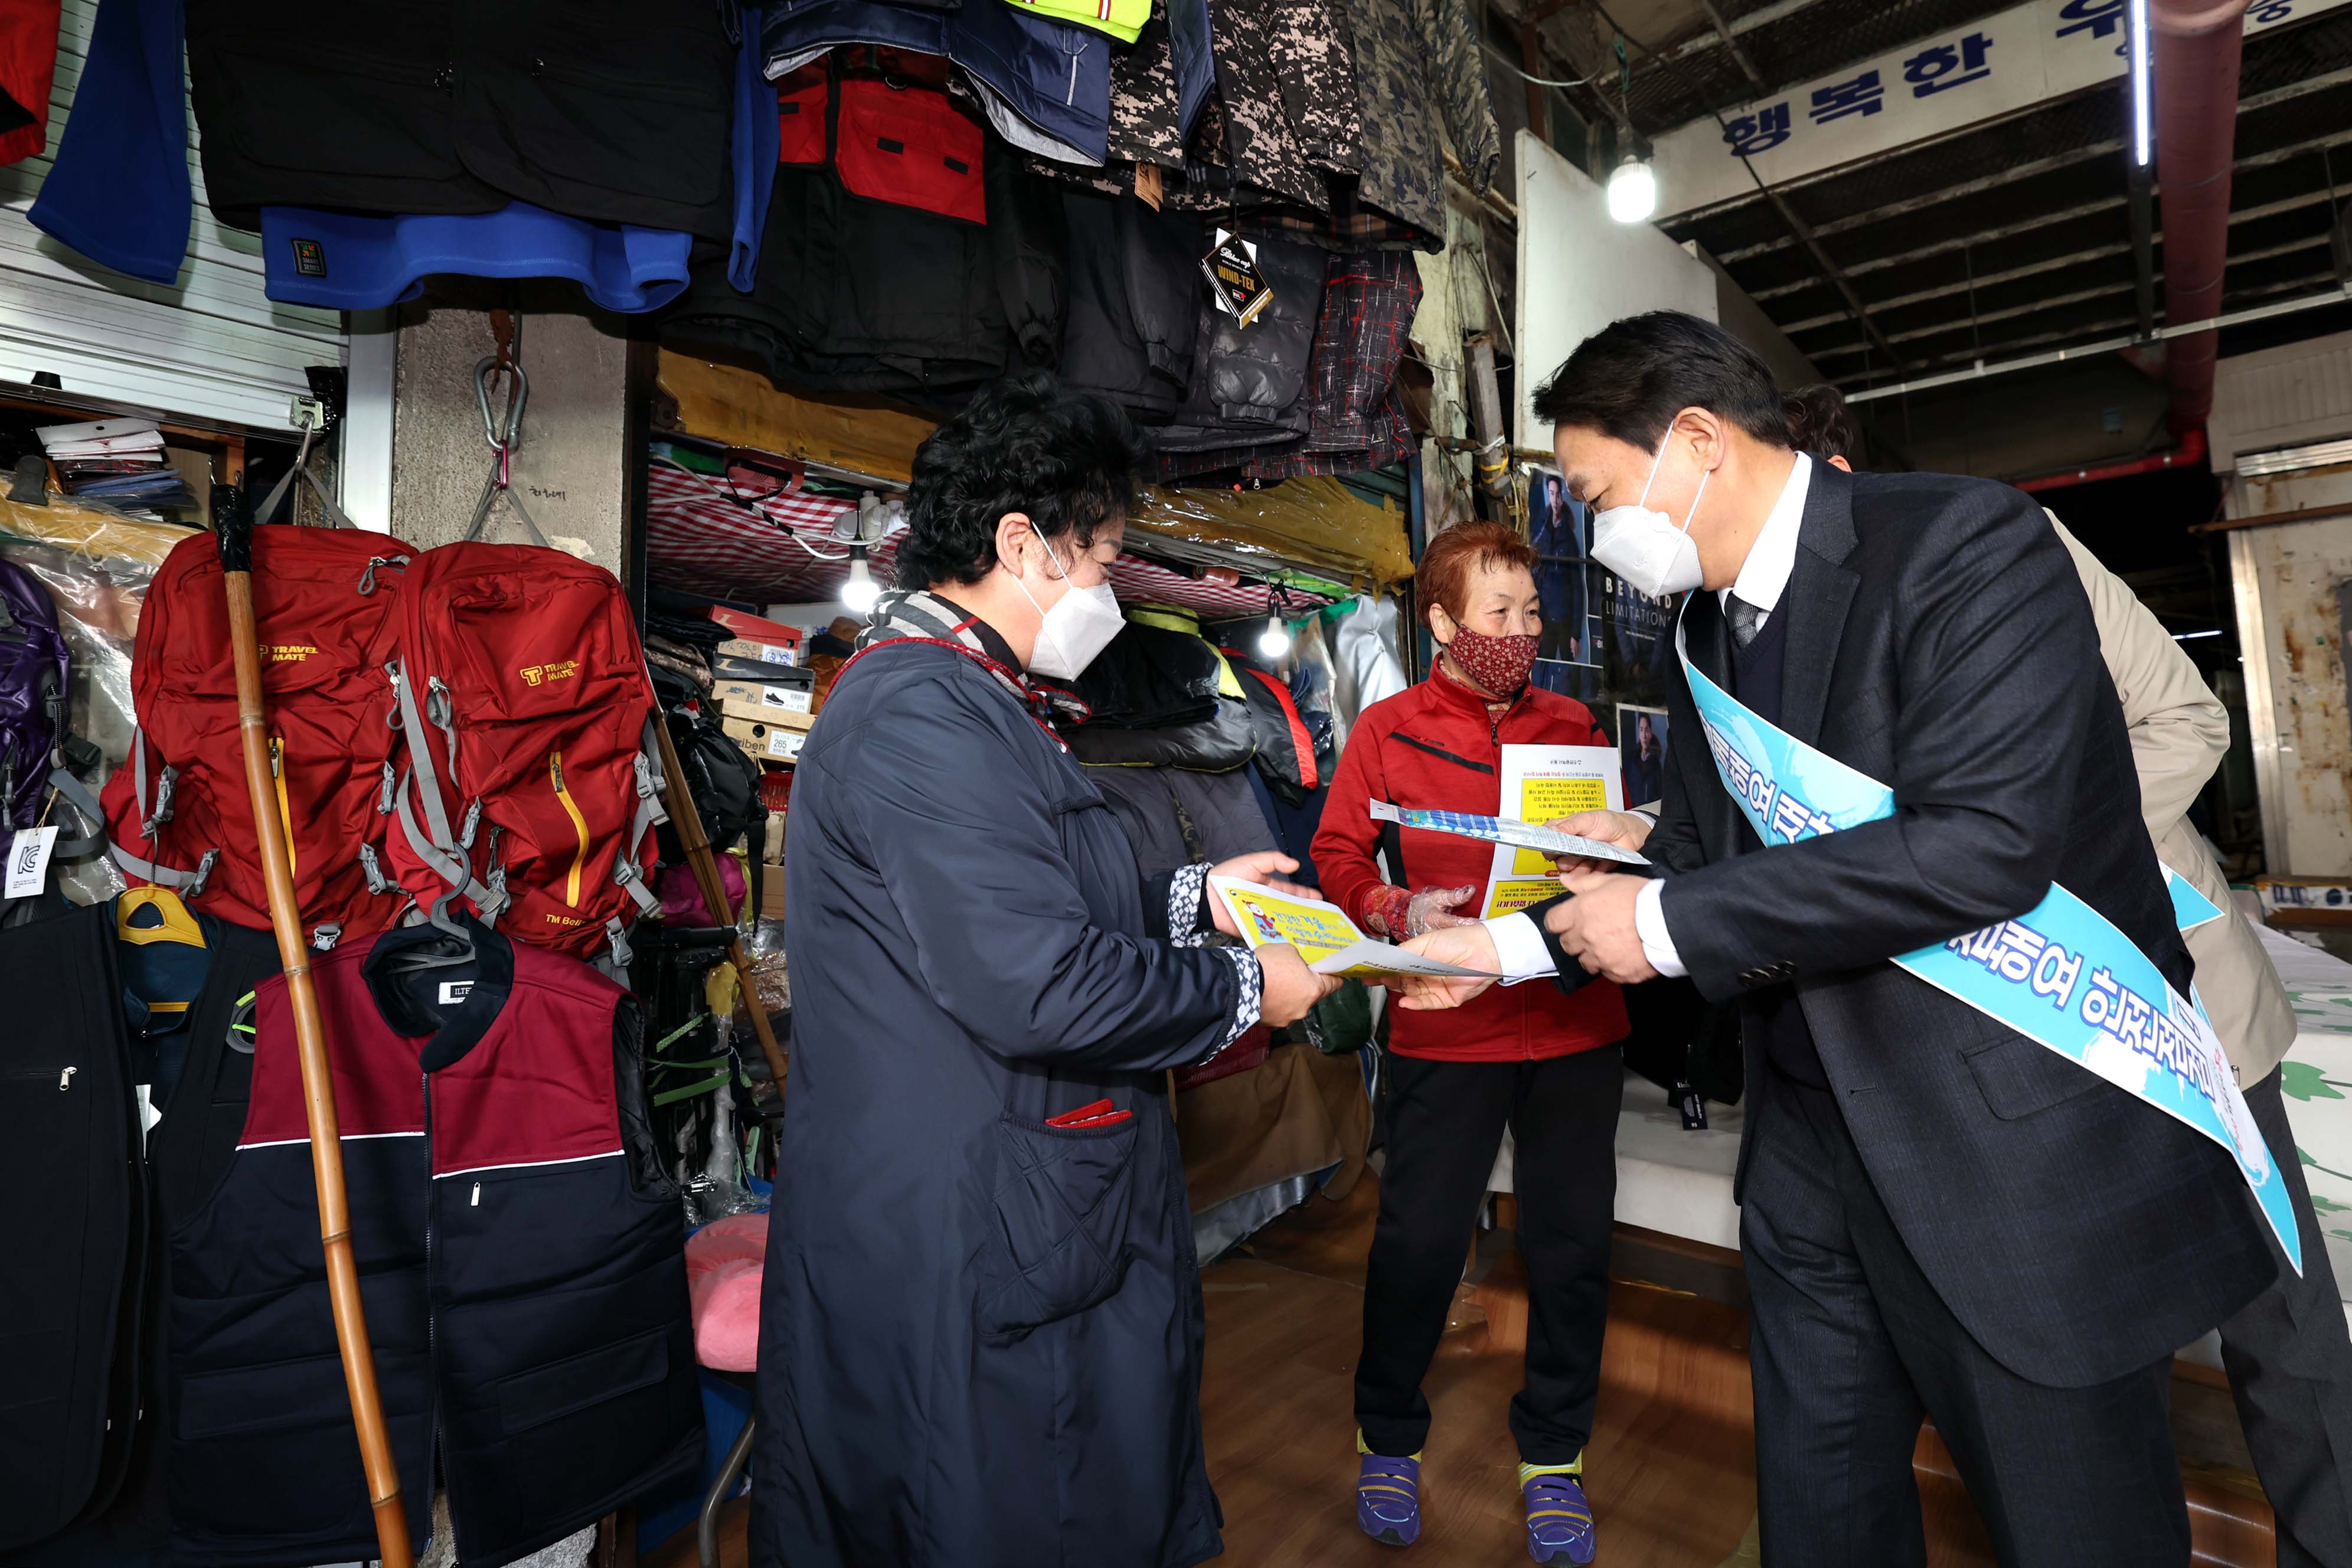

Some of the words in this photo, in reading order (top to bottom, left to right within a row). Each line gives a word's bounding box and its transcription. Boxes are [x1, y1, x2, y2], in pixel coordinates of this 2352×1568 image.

[1723, 32, 1994, 156] 행복한
[1217, 264, 1255, 292] WIND-TEX
[544, 661, 580, 672] TRAVEL
[547, 669, 574, 681] MATE
[774, 739, 787, 749] 265
[1698, 708, 1776, 821] 께해요
[546, 913, 561, 924] TM
